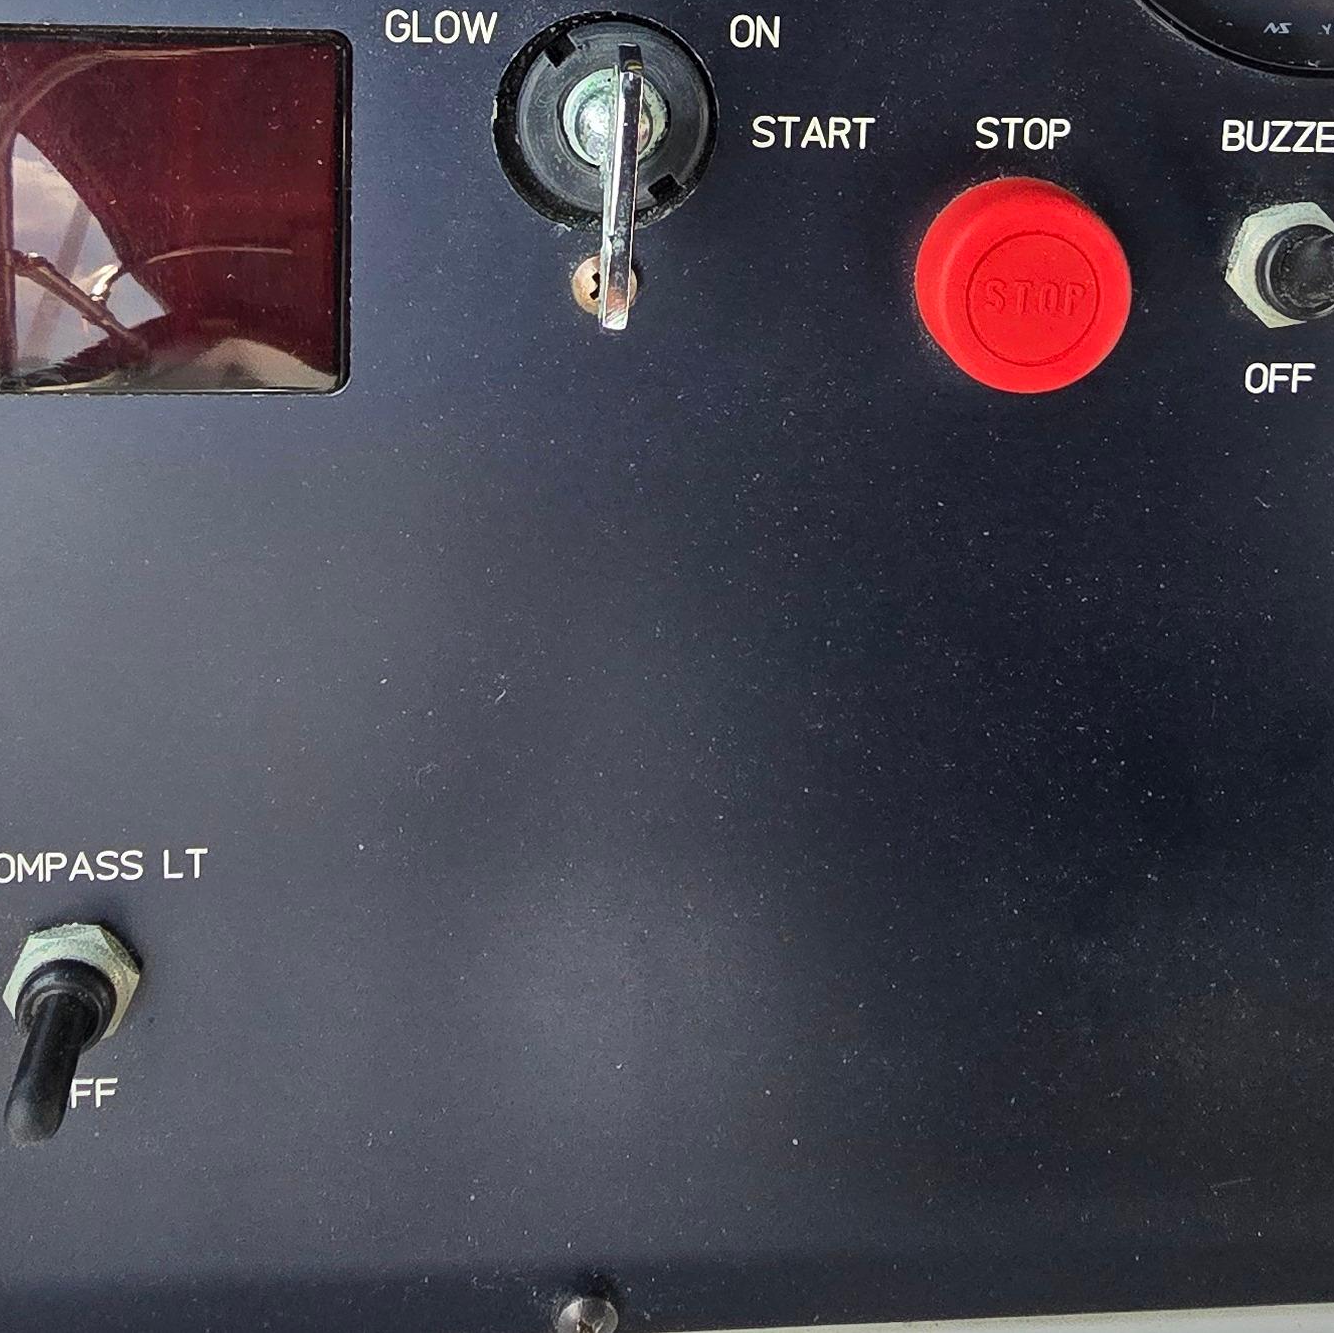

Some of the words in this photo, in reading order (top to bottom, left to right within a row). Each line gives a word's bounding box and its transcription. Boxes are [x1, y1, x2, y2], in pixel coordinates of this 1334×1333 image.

[384, 8, 498, 44] GLOW
[729, 14, 780, 49] ON
[751, 115, 876, 150] START
[975, 116, 1071, 151] STOP
[983, 277, 1087, 316] STOP
[1243, 362, 1316, 395] OFF
[163, 847, 209, 879] LT
[69, 1077, 118, 1108] FF
